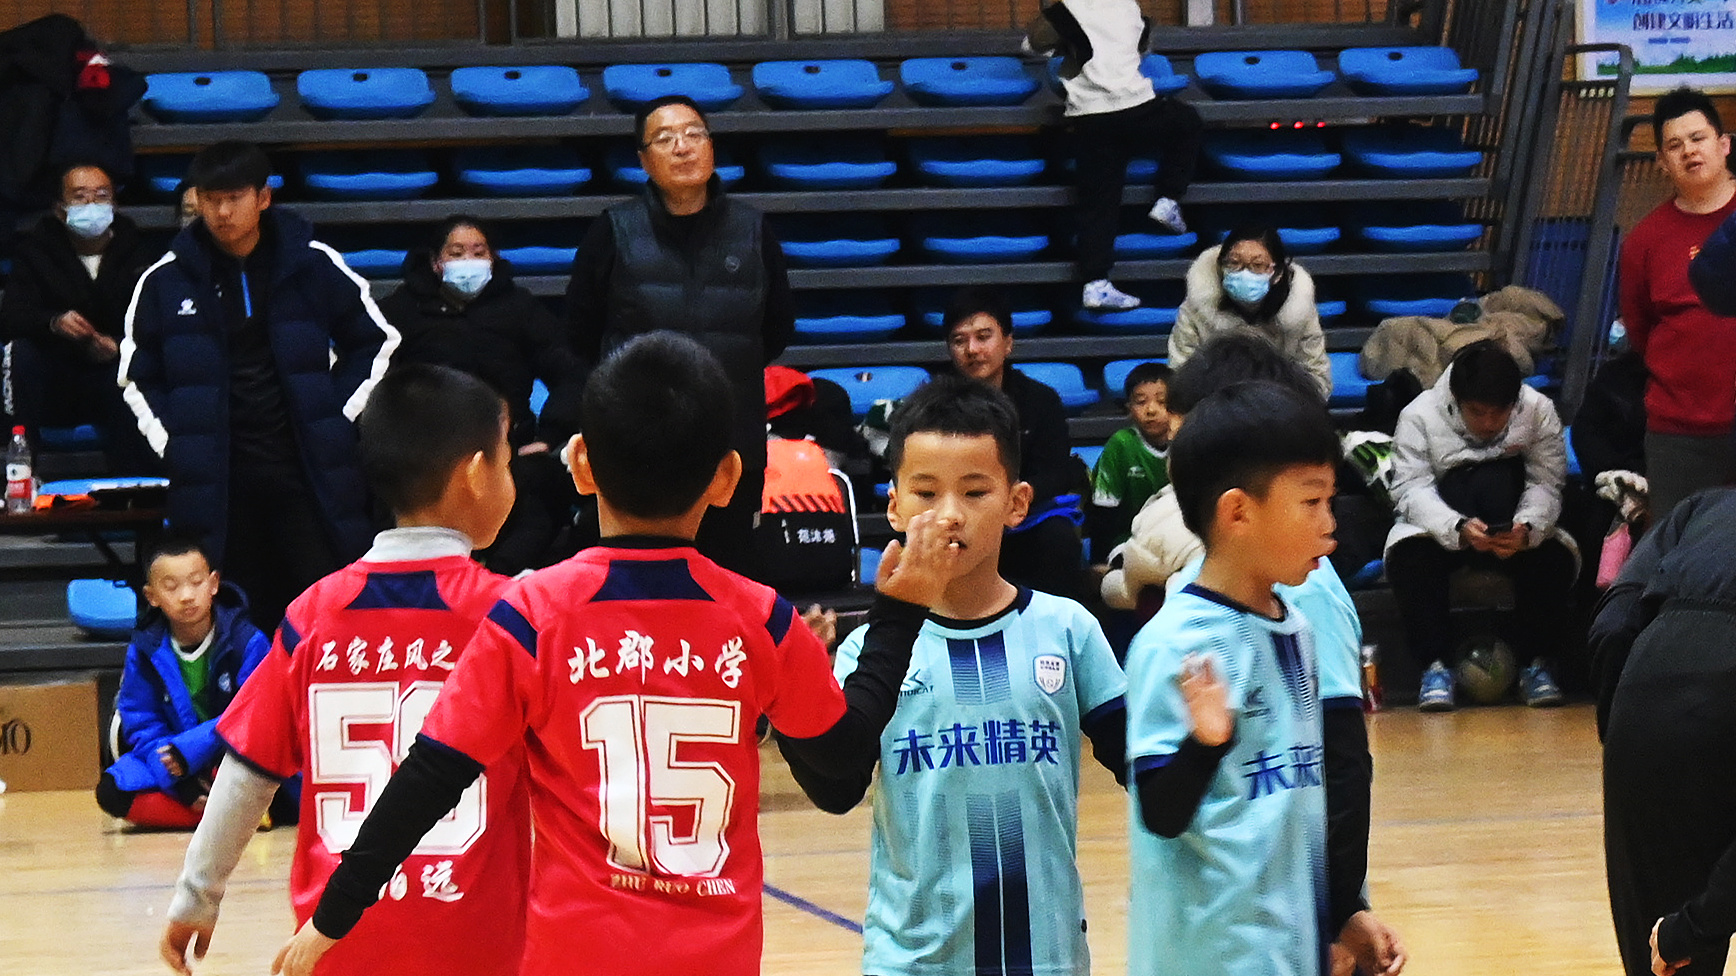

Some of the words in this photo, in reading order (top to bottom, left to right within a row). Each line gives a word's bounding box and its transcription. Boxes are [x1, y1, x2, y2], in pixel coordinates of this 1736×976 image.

[567, 629, 748, 689] 北郡小学
[892, 719, 1061, 776] 未来精英
[579, 694, 741, 878] 15
[696, 878, 737, 897] CHEN
